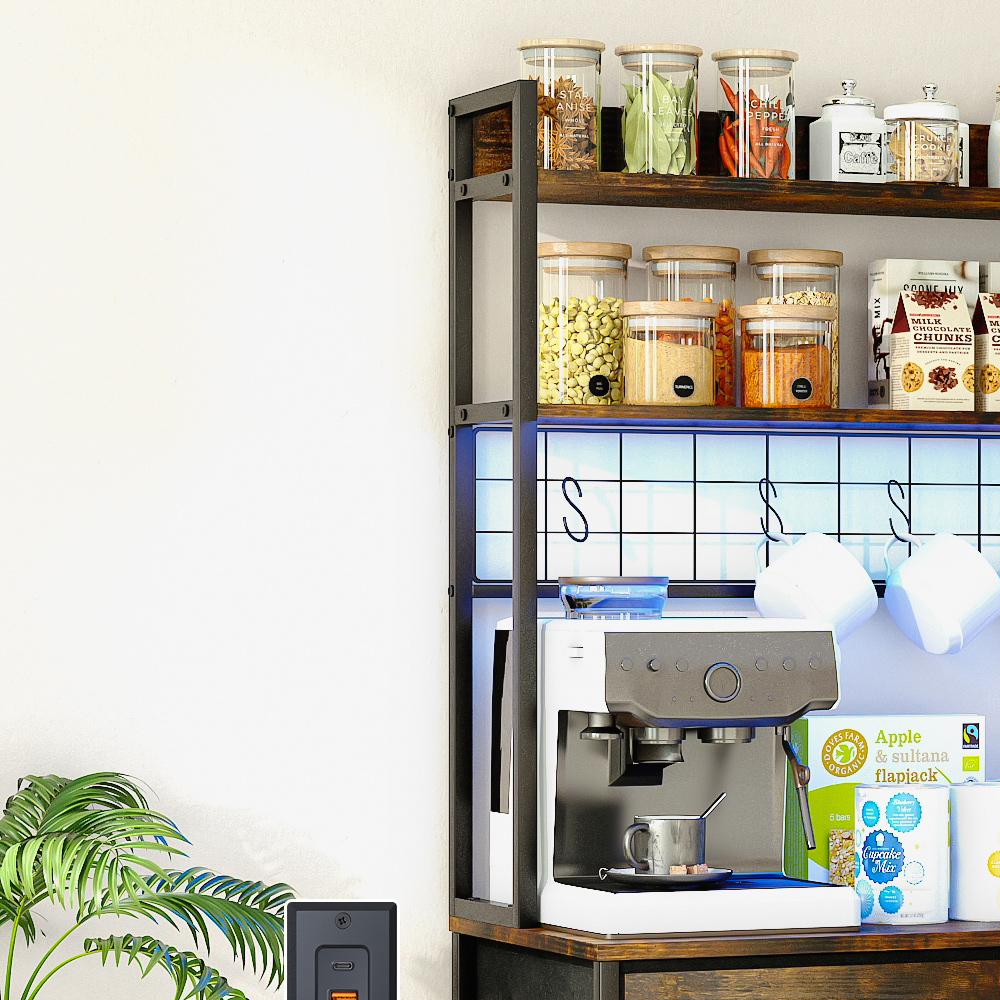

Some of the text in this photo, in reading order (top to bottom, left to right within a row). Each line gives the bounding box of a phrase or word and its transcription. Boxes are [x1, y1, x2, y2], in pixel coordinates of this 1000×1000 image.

[560, 90, 589, 100] STAR
[662, 95, 685, 104] BAY
[556, 102, 592, 112] ANISE
[913, 333, 973, 342] CHUNKS
[875, 729, 922, 747] Apple
[823, 731, 866, 761] DOVES FARM
[875, 748, 950, 763] & sultana
[828, 753, 865, 775] ORGANIC
[875, 768, 938, 784] flapjack
[830, 813, 851, 822] 5 bars
[863, 846, 902, 862] Cupcake
[871, 860, 897, 874] Mix
